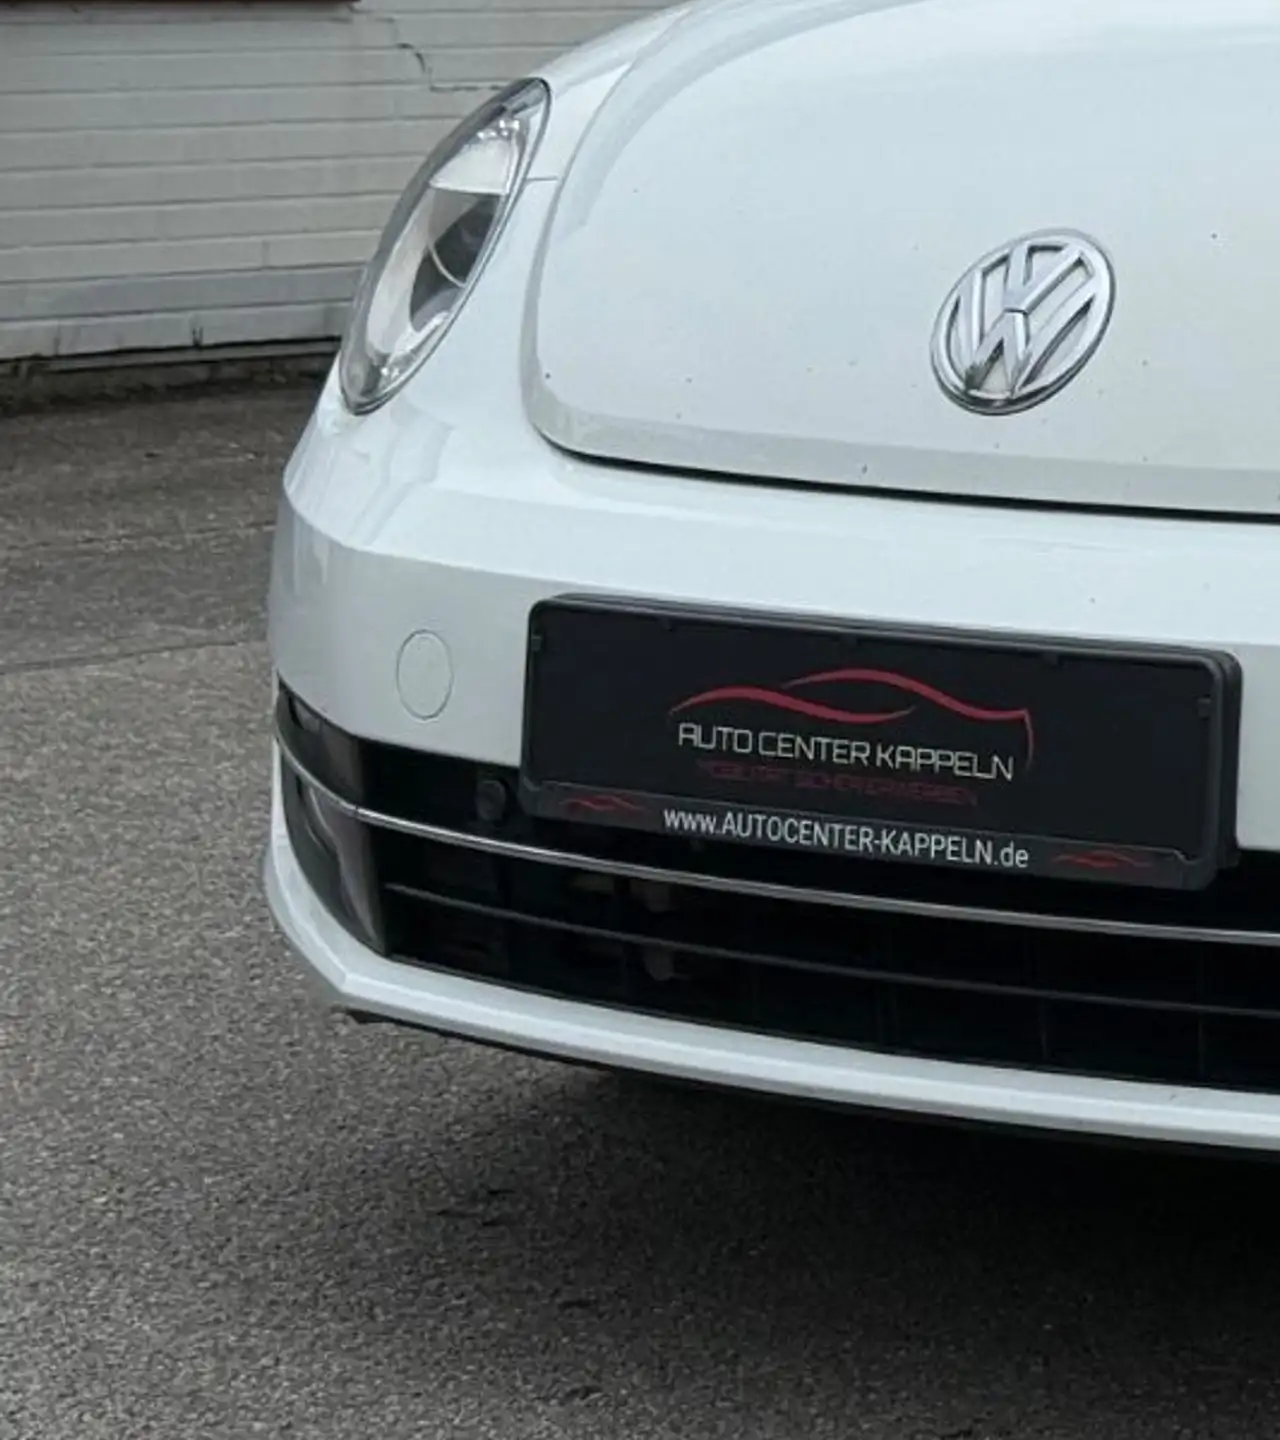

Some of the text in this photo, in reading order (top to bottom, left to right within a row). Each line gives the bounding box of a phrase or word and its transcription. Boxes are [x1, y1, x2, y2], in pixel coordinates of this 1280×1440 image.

[678, 722, 1014, 782] AUTO CENTER KAPPELN
[663, 808, 1029, 868] www.AUTOCENTER-KAPPELN.de
